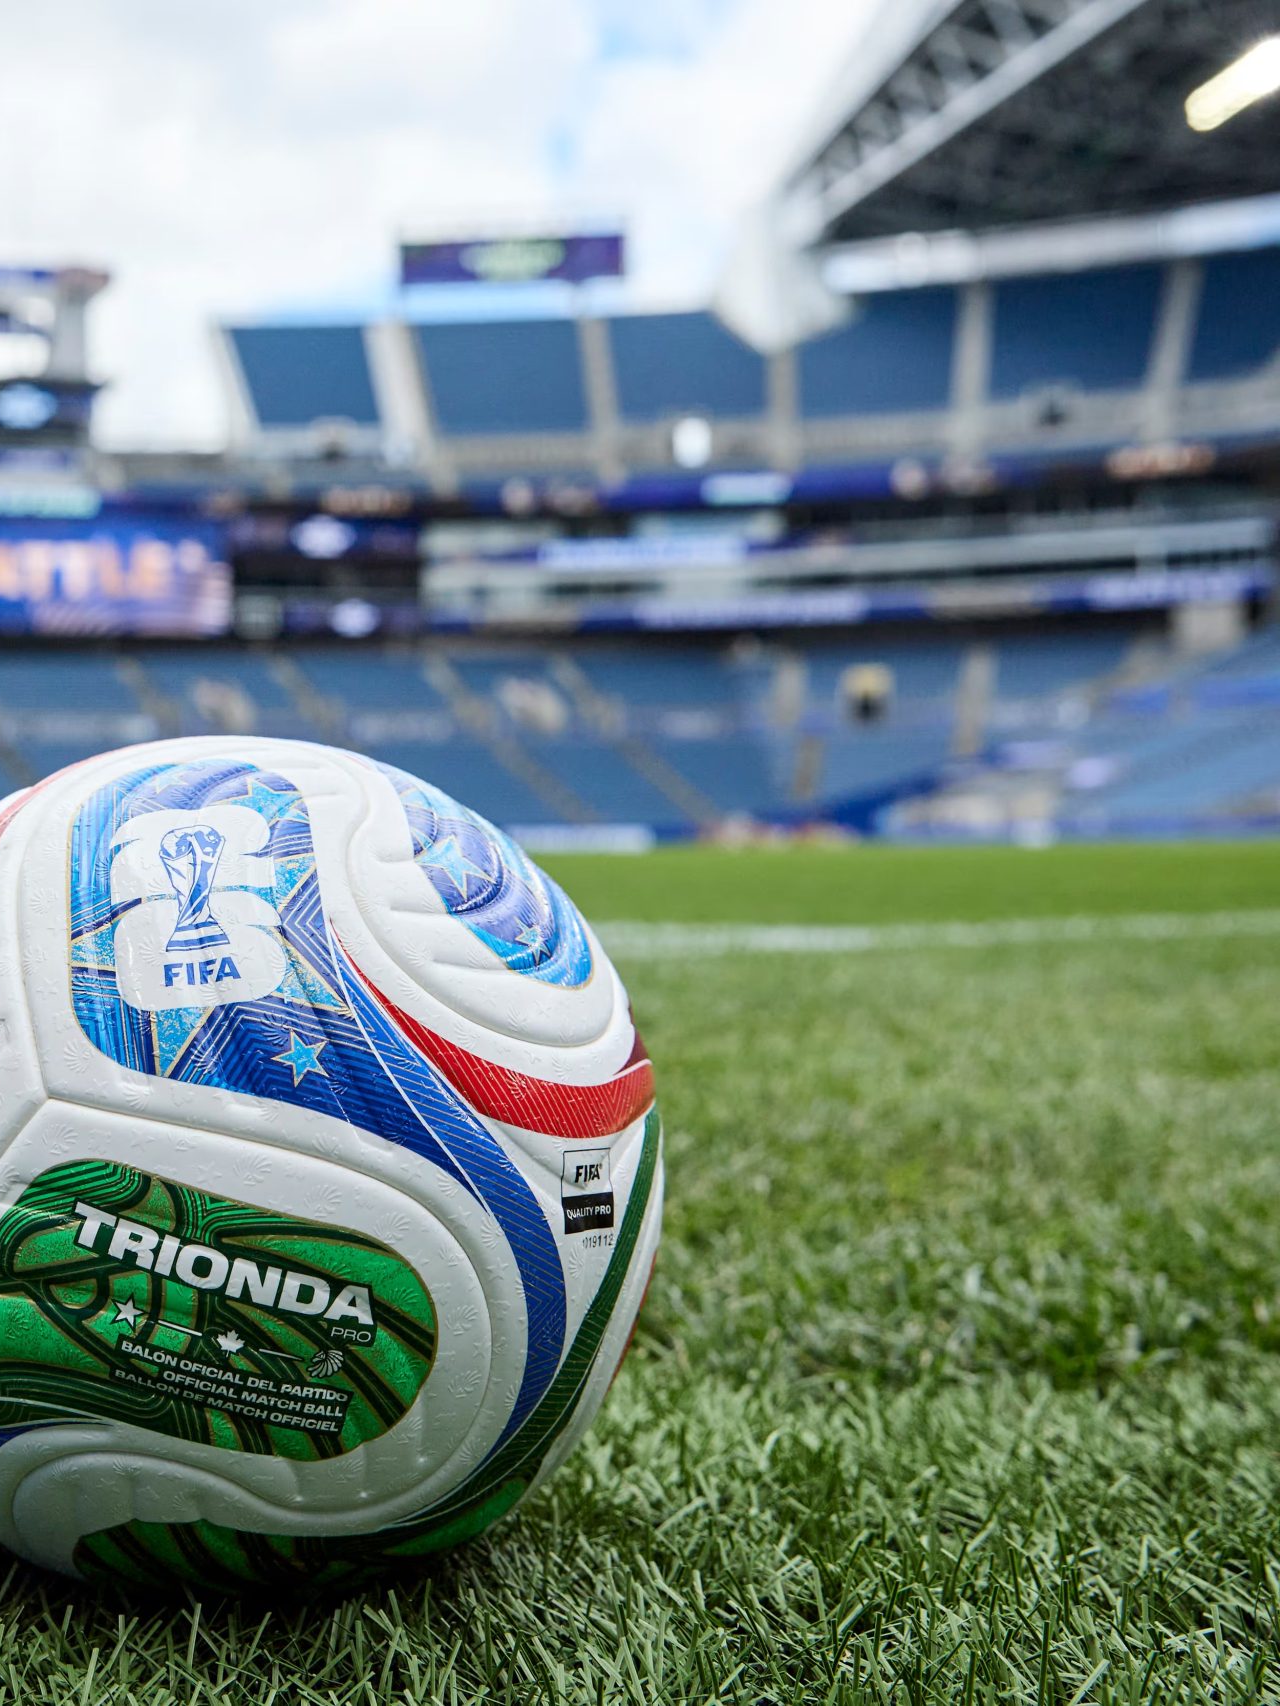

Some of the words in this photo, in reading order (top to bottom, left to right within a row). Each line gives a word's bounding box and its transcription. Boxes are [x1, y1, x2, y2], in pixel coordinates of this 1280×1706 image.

[163, 956, 241, 987] FIFA
[566, 1206, 594, 1219] QUALITY
[594, 1204, 612, 1216] PRO
[74, 1201, 375, 1325] TRIONDA
[330, 1326, 372, 1344] PRO
[120, 1339, 179, 1368] BALÓN
[179, 1359, 245, 1386] OFICIAL
[246, 1376, 278, 1393] DEL
[279, 1383, 349, 1403] PARTIDO
[162, 1369, 238, 1399] OFFICIAL
[240, 1391, 302, 1412] MATCH
[303, 1403, 344, 1418] BALL
[114, 1369, 180, 1395] BALLON
[183, 1389, 206, 1402] DE
[206, 1398, 269, 1420] MATCH
[269, 1411, 340, 1433] OFFICIEL
